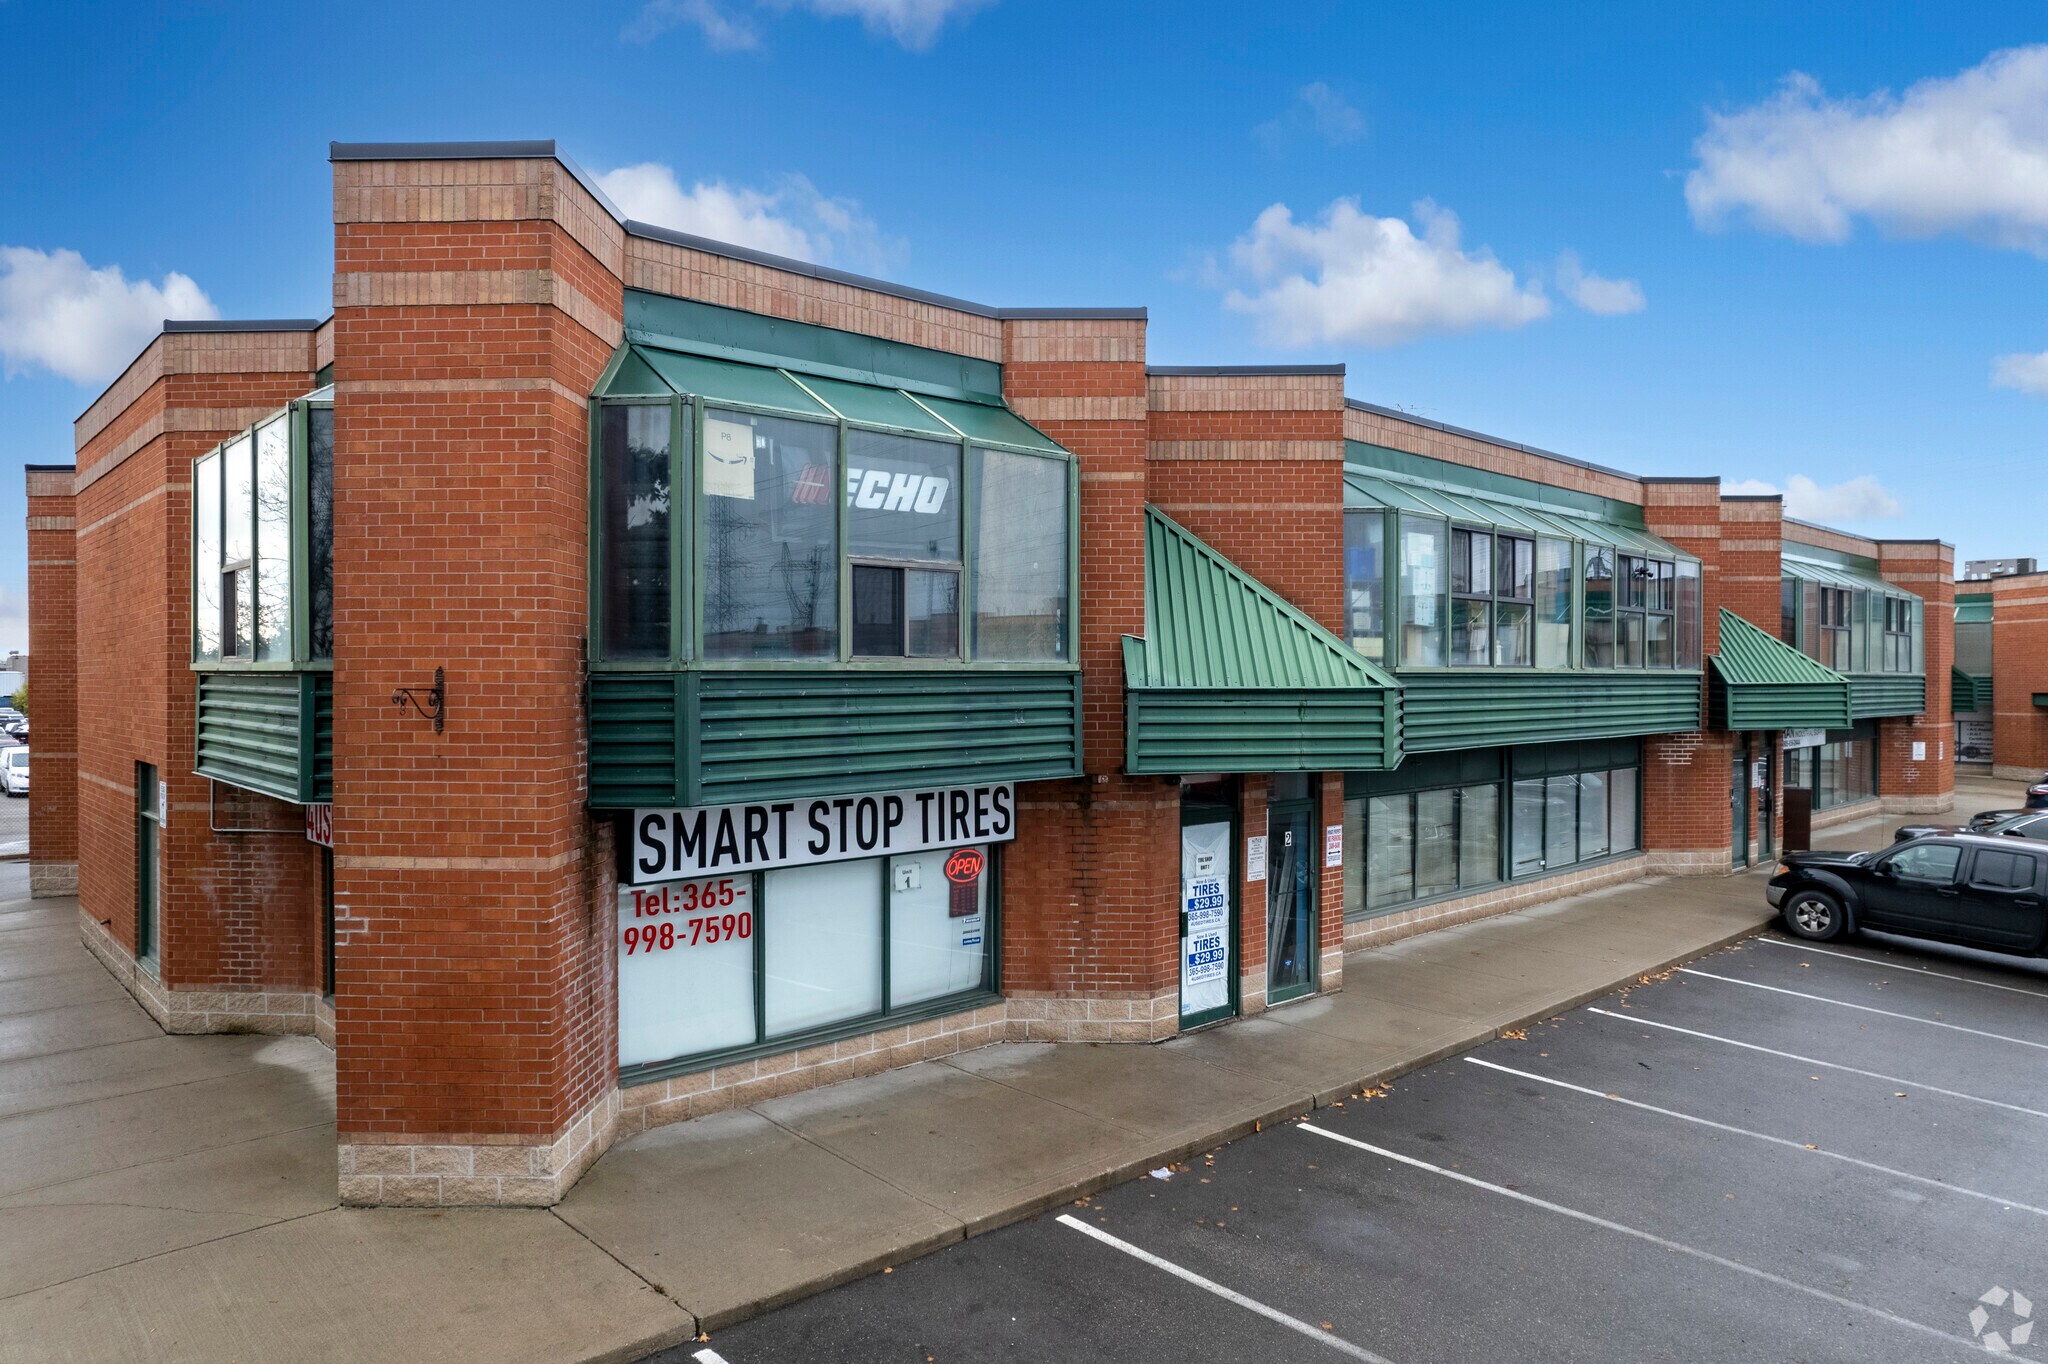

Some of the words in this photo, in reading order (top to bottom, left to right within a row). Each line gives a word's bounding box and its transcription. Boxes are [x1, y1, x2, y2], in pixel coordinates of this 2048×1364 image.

[721, 431, 732, 442] P8
[638, 803, 795, 875] SMART
[807, 790, 903, 856] STOP
[916, 785, 1012, 845] TIRES
[1285, 832, 1291, 845] 2
[948, 857, 981, 876] OPEN
[904, 876, 910, 888] 1
[1192, 883, 1220, 897] TIRES
[630, 879, 746, 918] Tel:365-
[1193, 896, 1223, 910] $29.99
[1188, 908, 1223, 921] 365-998-7590
[623, 912, 752, 956] 998-7590
[1193, 936, 1221, 952] TIRES
[1194, 949, 1223, 965] $29.99
[1188, 962, 1225, 977] 365-998-7590
